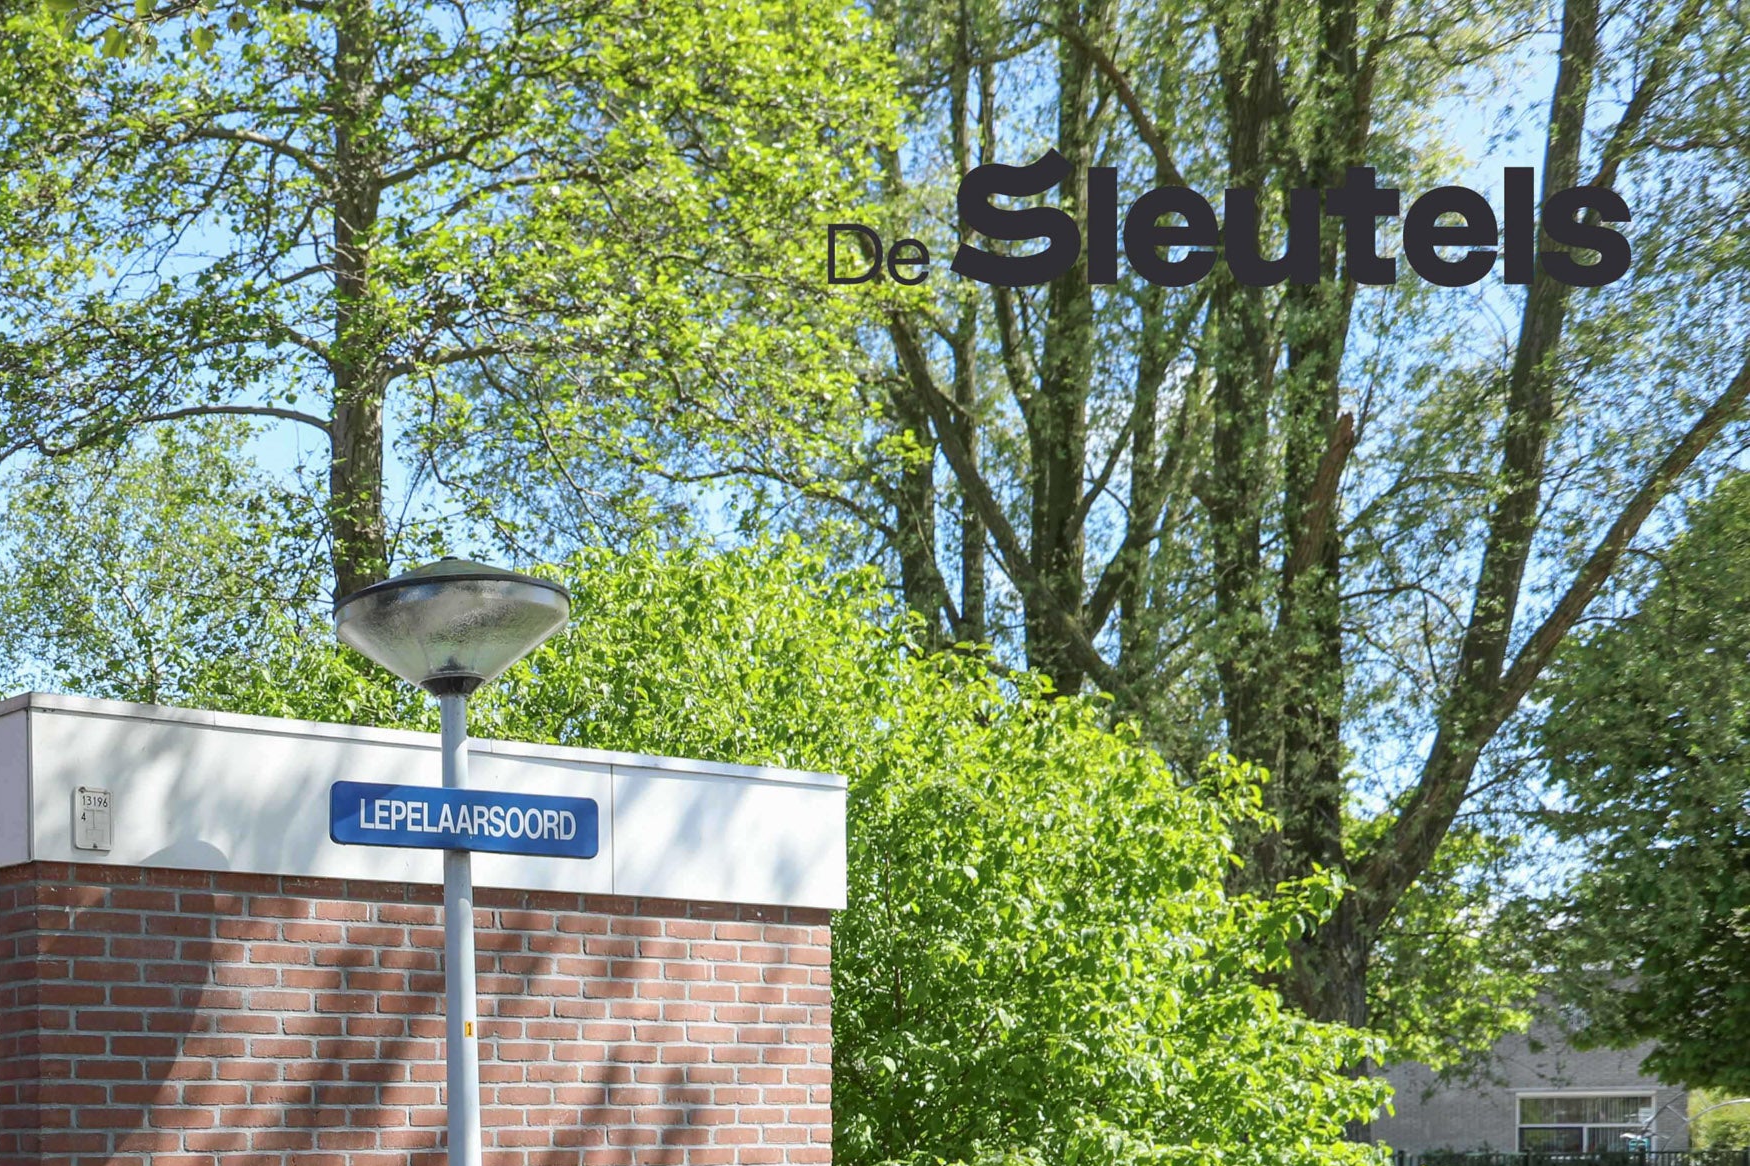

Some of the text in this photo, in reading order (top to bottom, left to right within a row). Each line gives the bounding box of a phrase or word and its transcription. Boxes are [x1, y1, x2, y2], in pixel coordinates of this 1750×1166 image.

[82, 795, 108, 808] 13196
[80, 812, 87, 822] 4
[359, 797, 577, 841] LEPELAARSOORD
